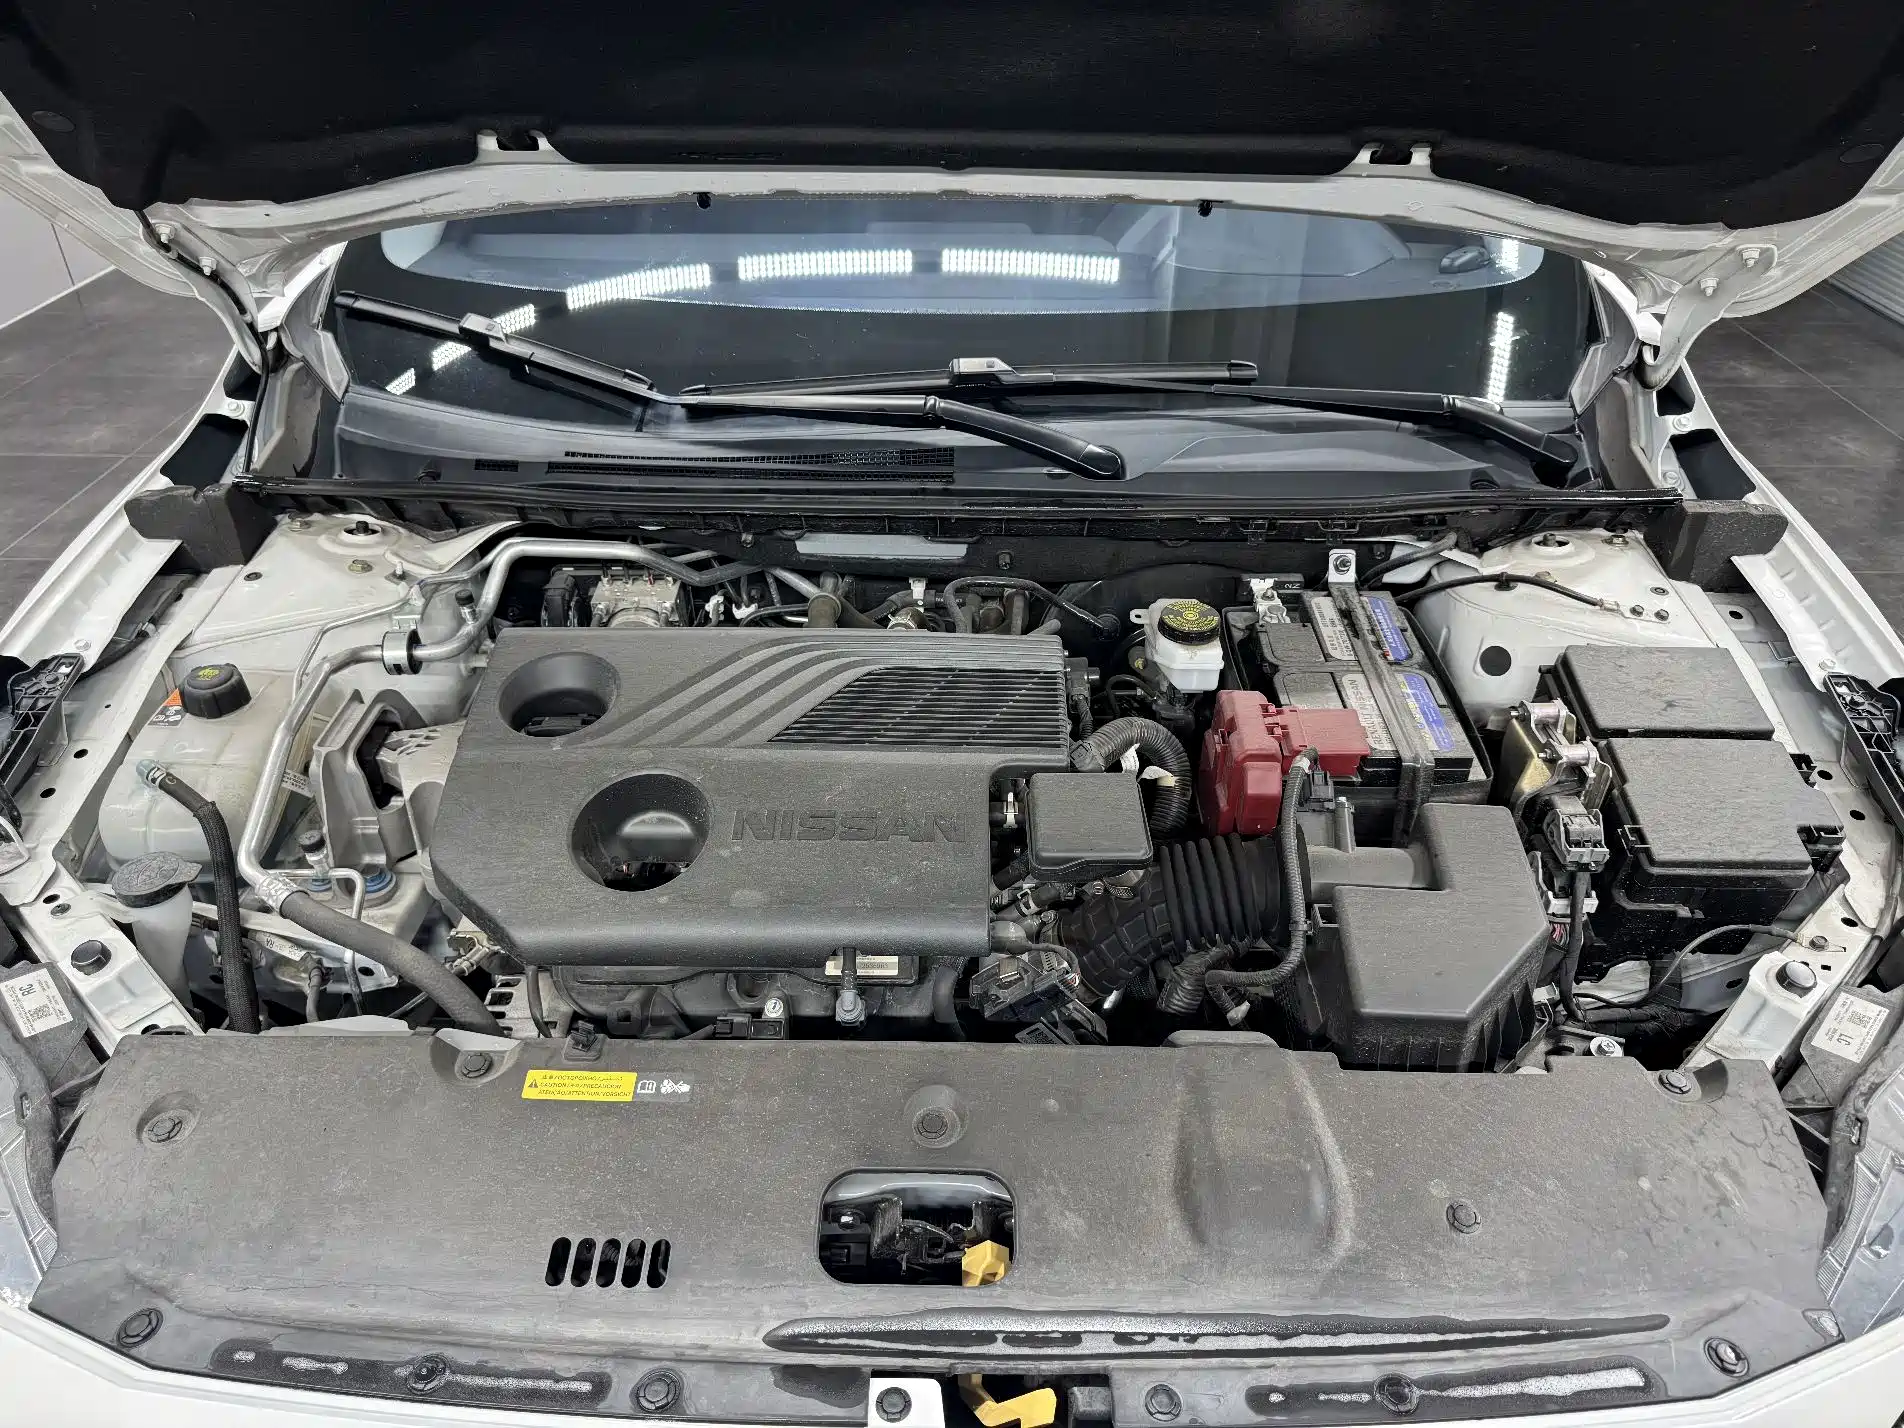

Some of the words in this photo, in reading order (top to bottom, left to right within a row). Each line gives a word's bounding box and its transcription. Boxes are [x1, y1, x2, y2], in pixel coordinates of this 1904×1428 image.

[731, 809, 966, 843] NISSAN
[19, 984, 36, 997] RC
[1837, 1033, 1854, 1046] LC
